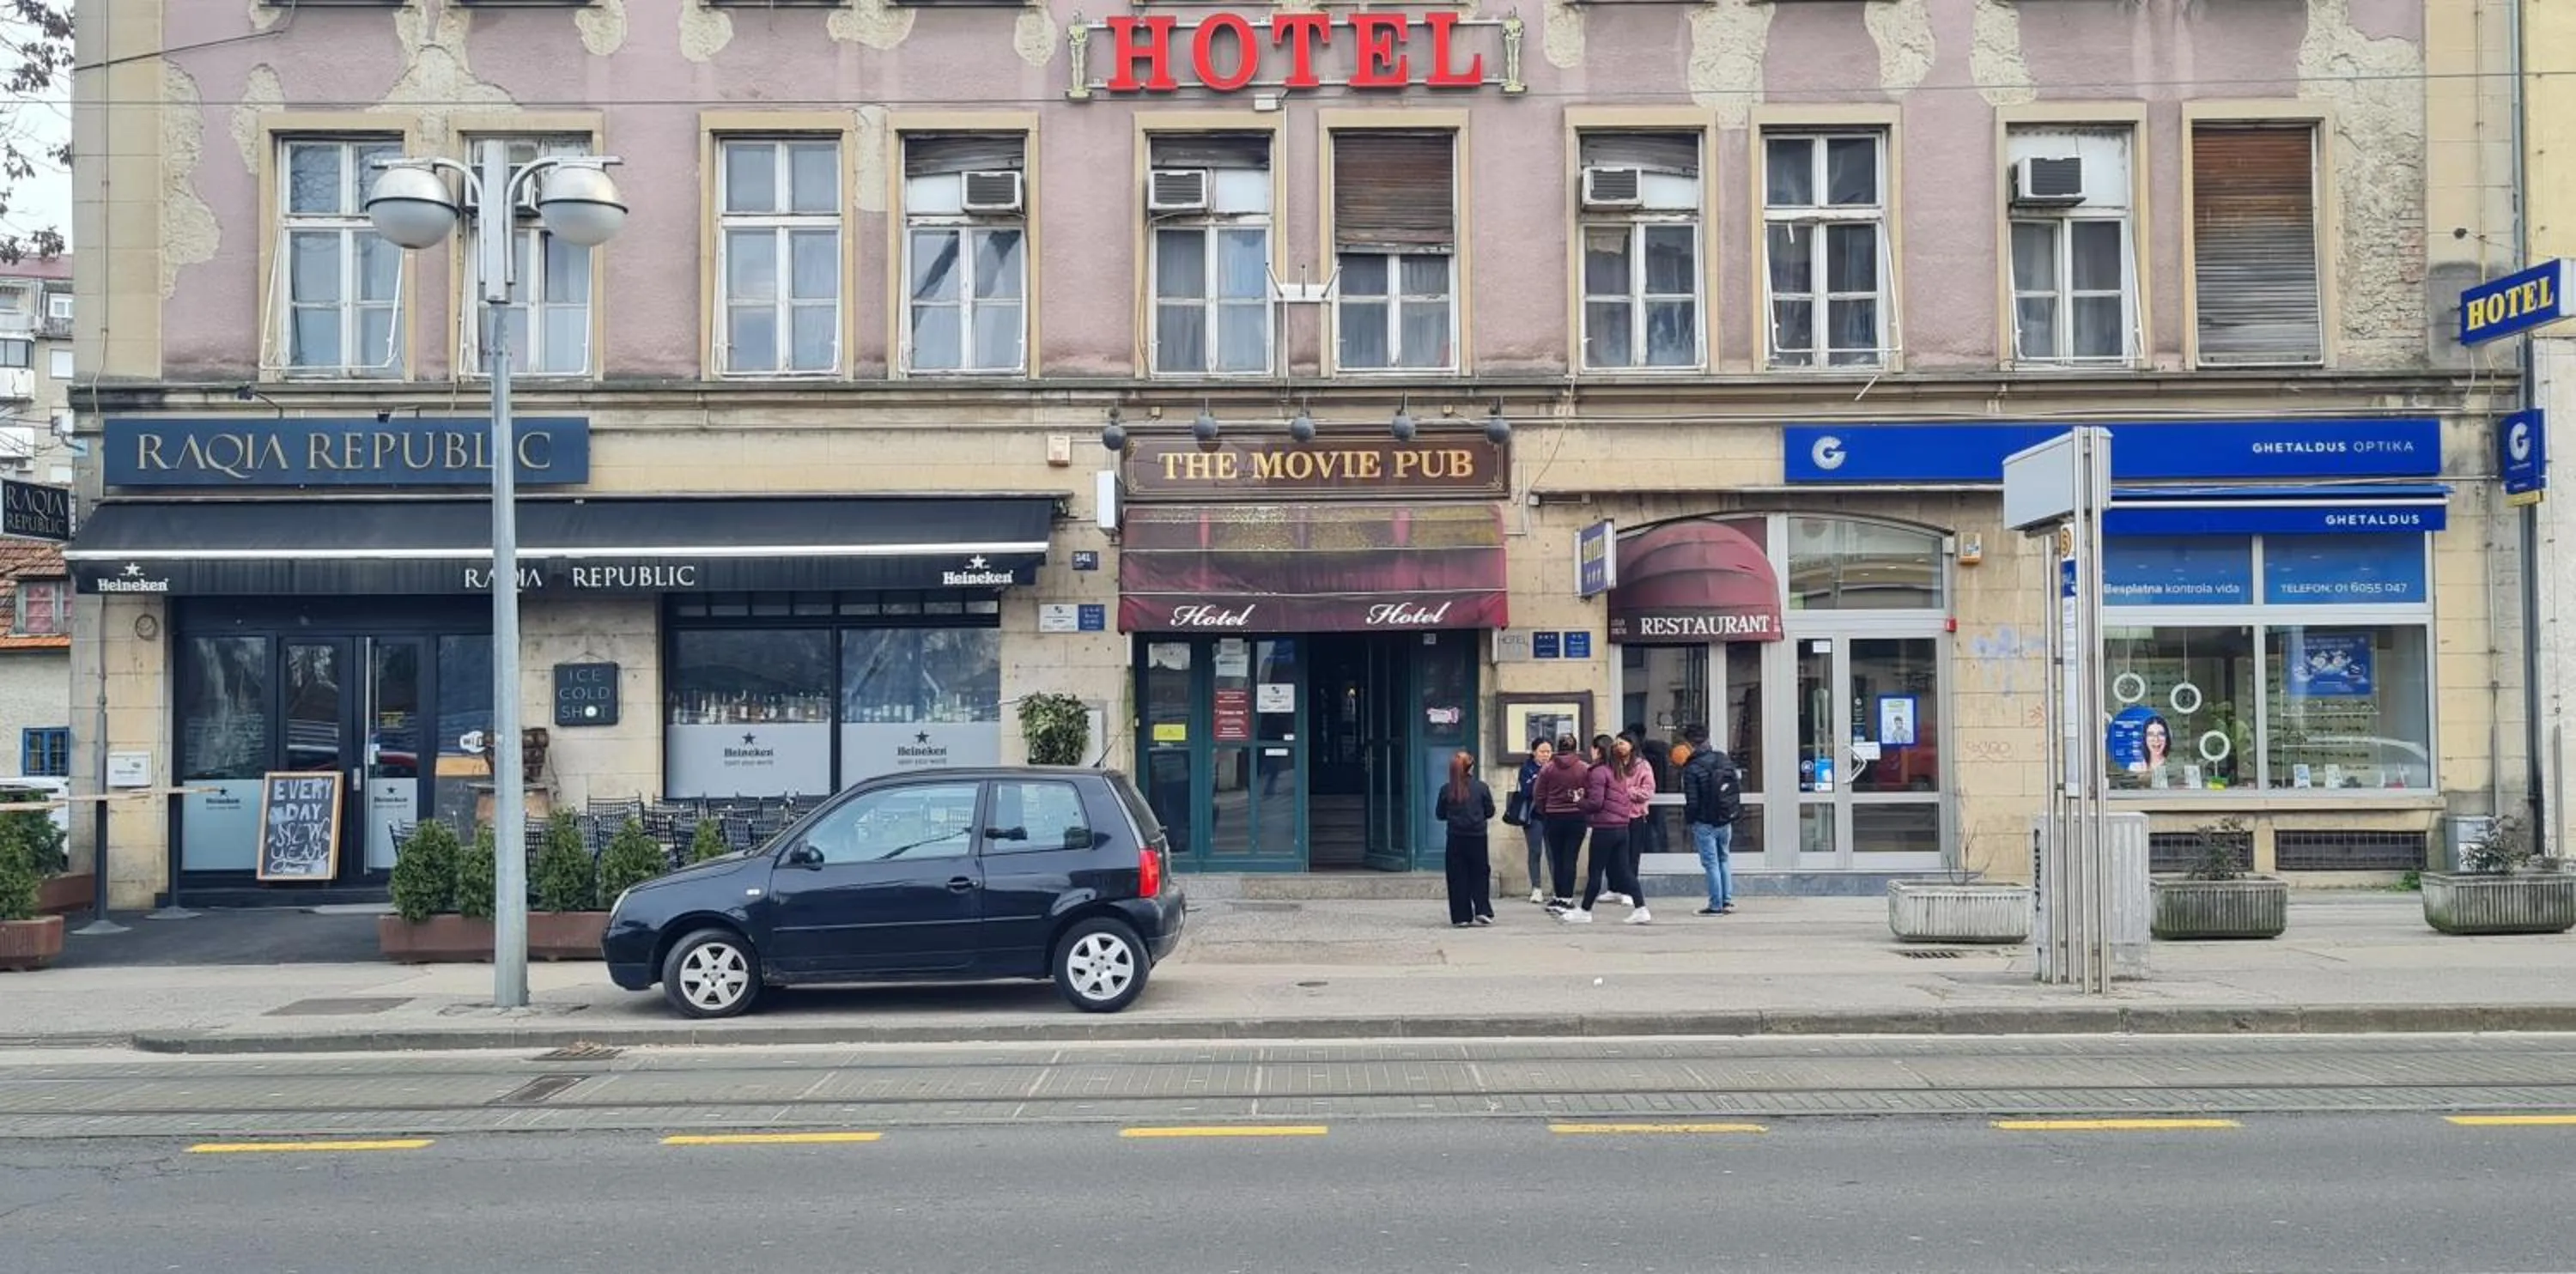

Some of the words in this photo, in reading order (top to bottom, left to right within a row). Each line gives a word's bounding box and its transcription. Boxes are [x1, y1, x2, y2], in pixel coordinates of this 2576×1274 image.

[1107, 12, 1483, 93] HOTEL
[2466, 276, 2553, 331] HOTEL
[2252, 442, 2347, 453] GHETALDUS
[2353, 440, 2414, 452] OPTIKA
[2509, 422, 2531, 461] G
[137, 433, 289, 479] RAQIA
[307, 432, 551, 469] REPUBLC
[1812, 436, 1847, 470] G
[1157, 452, 1237, 480] THE
[1252, 451, 1382, 479] MOVIE
[1392, 449, 1474, 477] PUB
[5, 485, 65, 519] RAQIA
[6, 513, 65, 535] REPUBLIC
[2325, 513, 2421, 526] GHETALDUS
[97, 578, 169, 592] Heineken
[465, 568, 543, 592] RAIA
[572, 566, 696, 587] REPUBLIC
[943, 570, 1014, 585] Heineken
[2281, 583, 2333, 593] TELEFON:
[2335, 583, 2348, 593] 01
[2350, 582, 2383, 593] 6055
[2385, 582, 2408, 593] 047
[2104, 583, 2163, 595] Besplatna
[2166, 584, 2213, 594] kontrola
[2215, 583, 2240, 594] vida
[1170, 604, 1255, 628] Hotel
[1366, 601, 1450, 626] Hotel
[1640, 615, 1771, 634] RESTAURANT
[568, 670, 602, 682] ICE
[559, 688, 611, 700] COLD
[274, 780, 332, 800] EVERY
[285, 804, 321, 821] DAY
